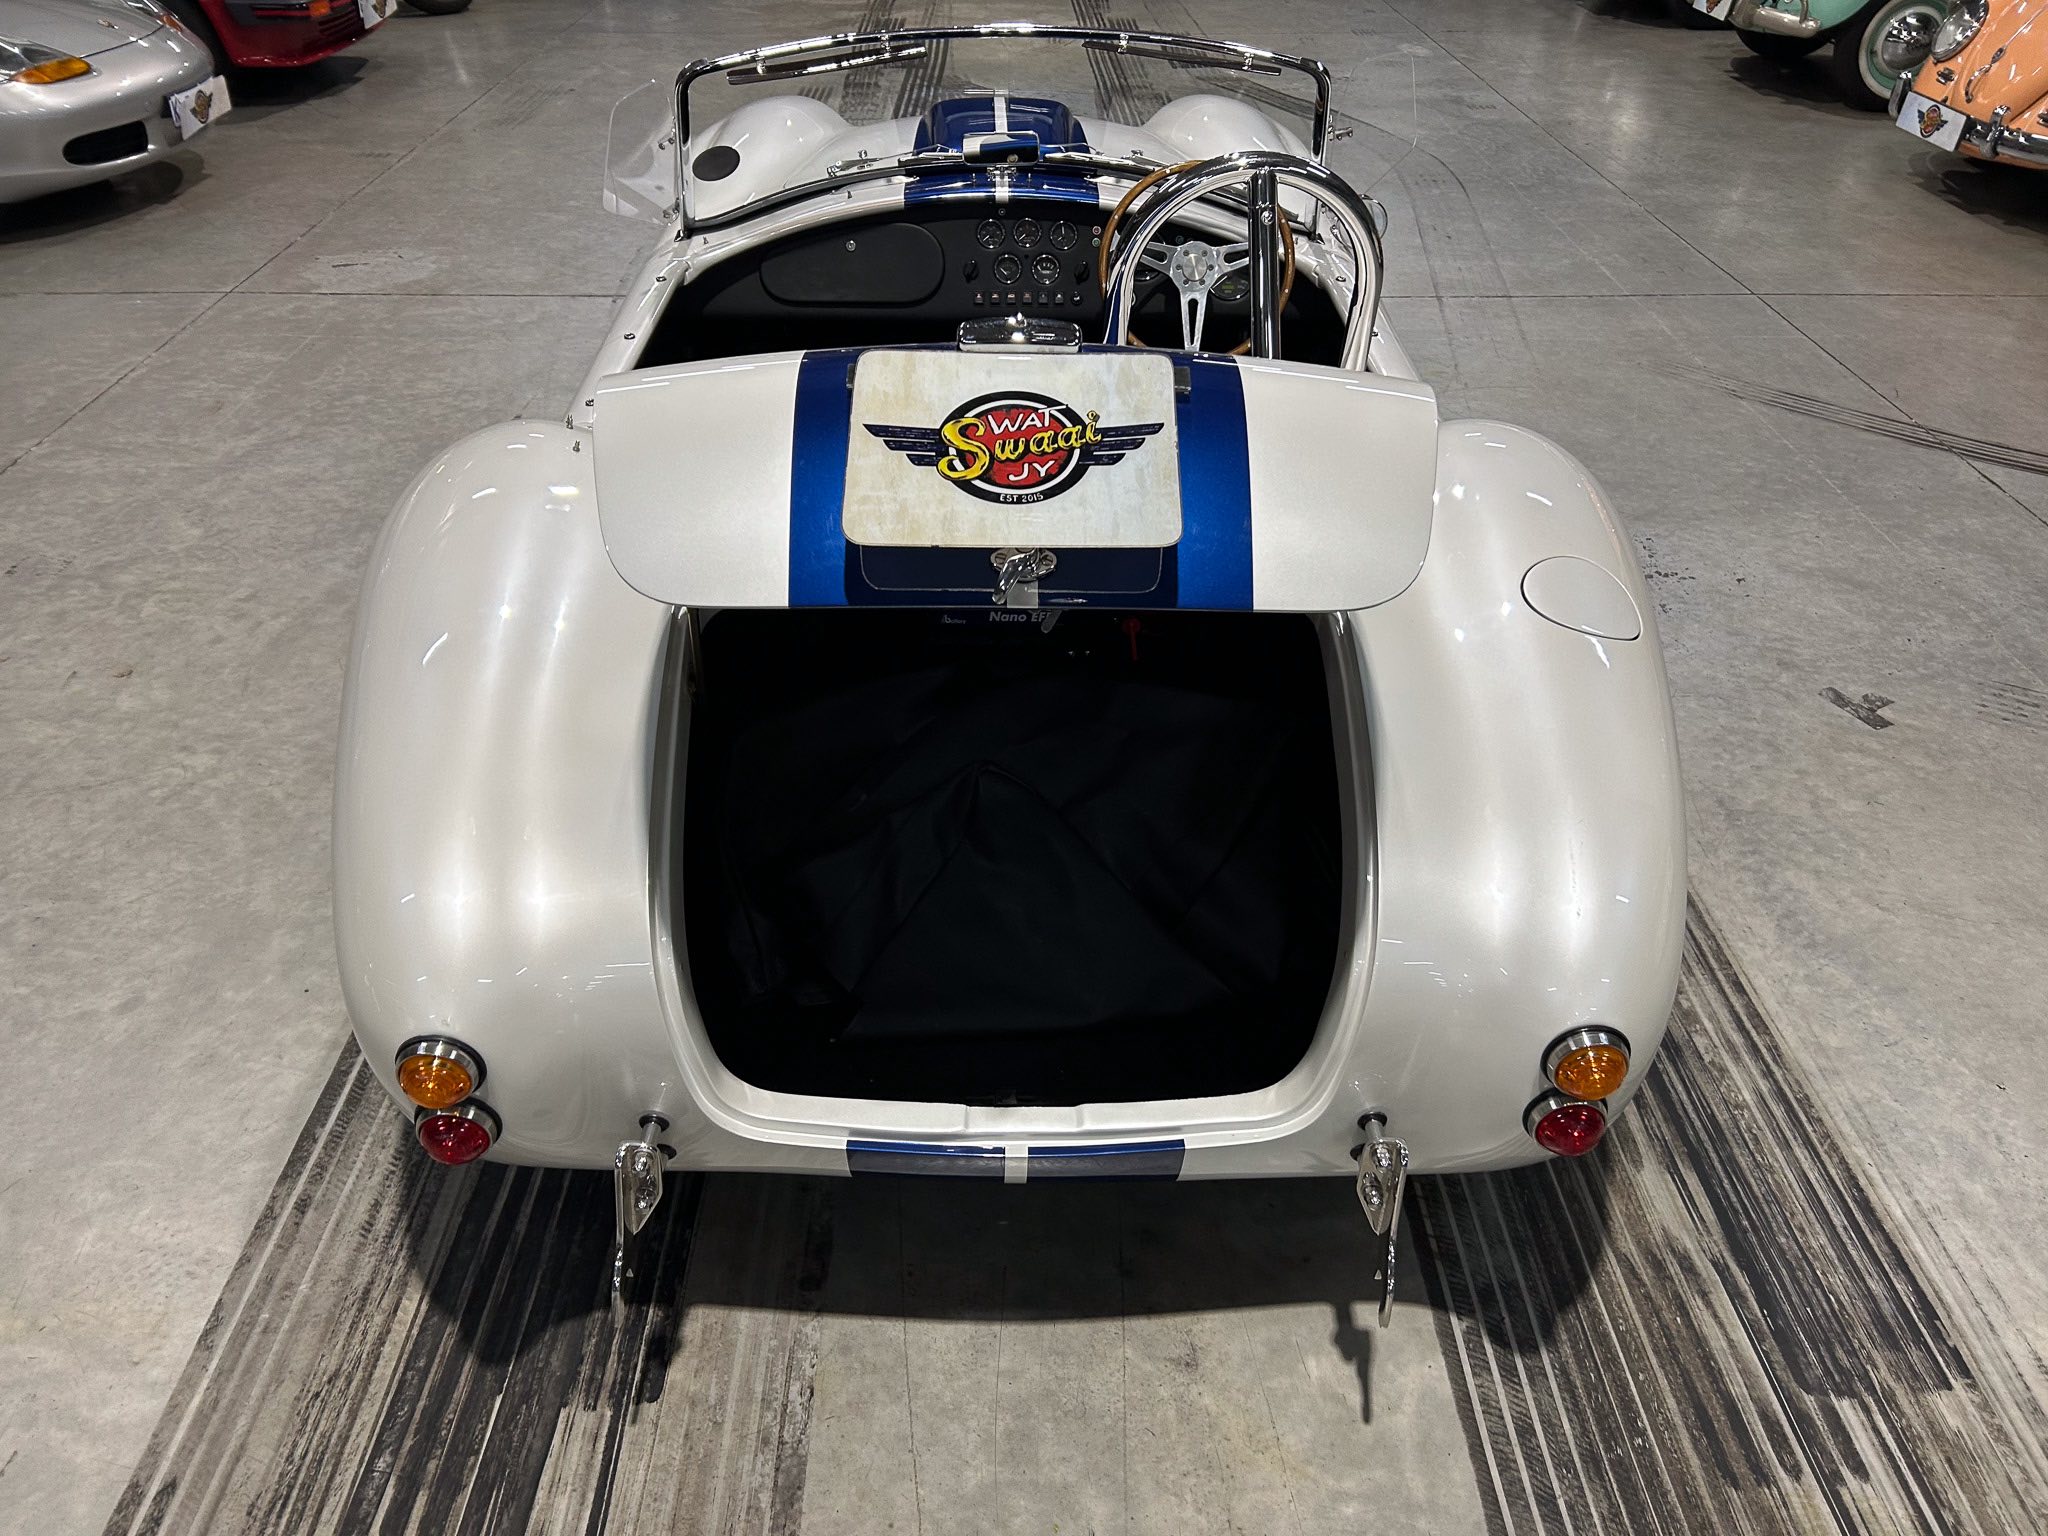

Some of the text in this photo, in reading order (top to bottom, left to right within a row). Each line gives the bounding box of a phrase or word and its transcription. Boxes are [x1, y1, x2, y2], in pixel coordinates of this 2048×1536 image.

[988, 405, 1068, 435] WAT
[937, 410, 1102, 480] Swaai
[1009, 461, 1055, 482] JY
[1000, 493, 1044, 503] EST 2015
[989, 611, 1027, 622] Nano
